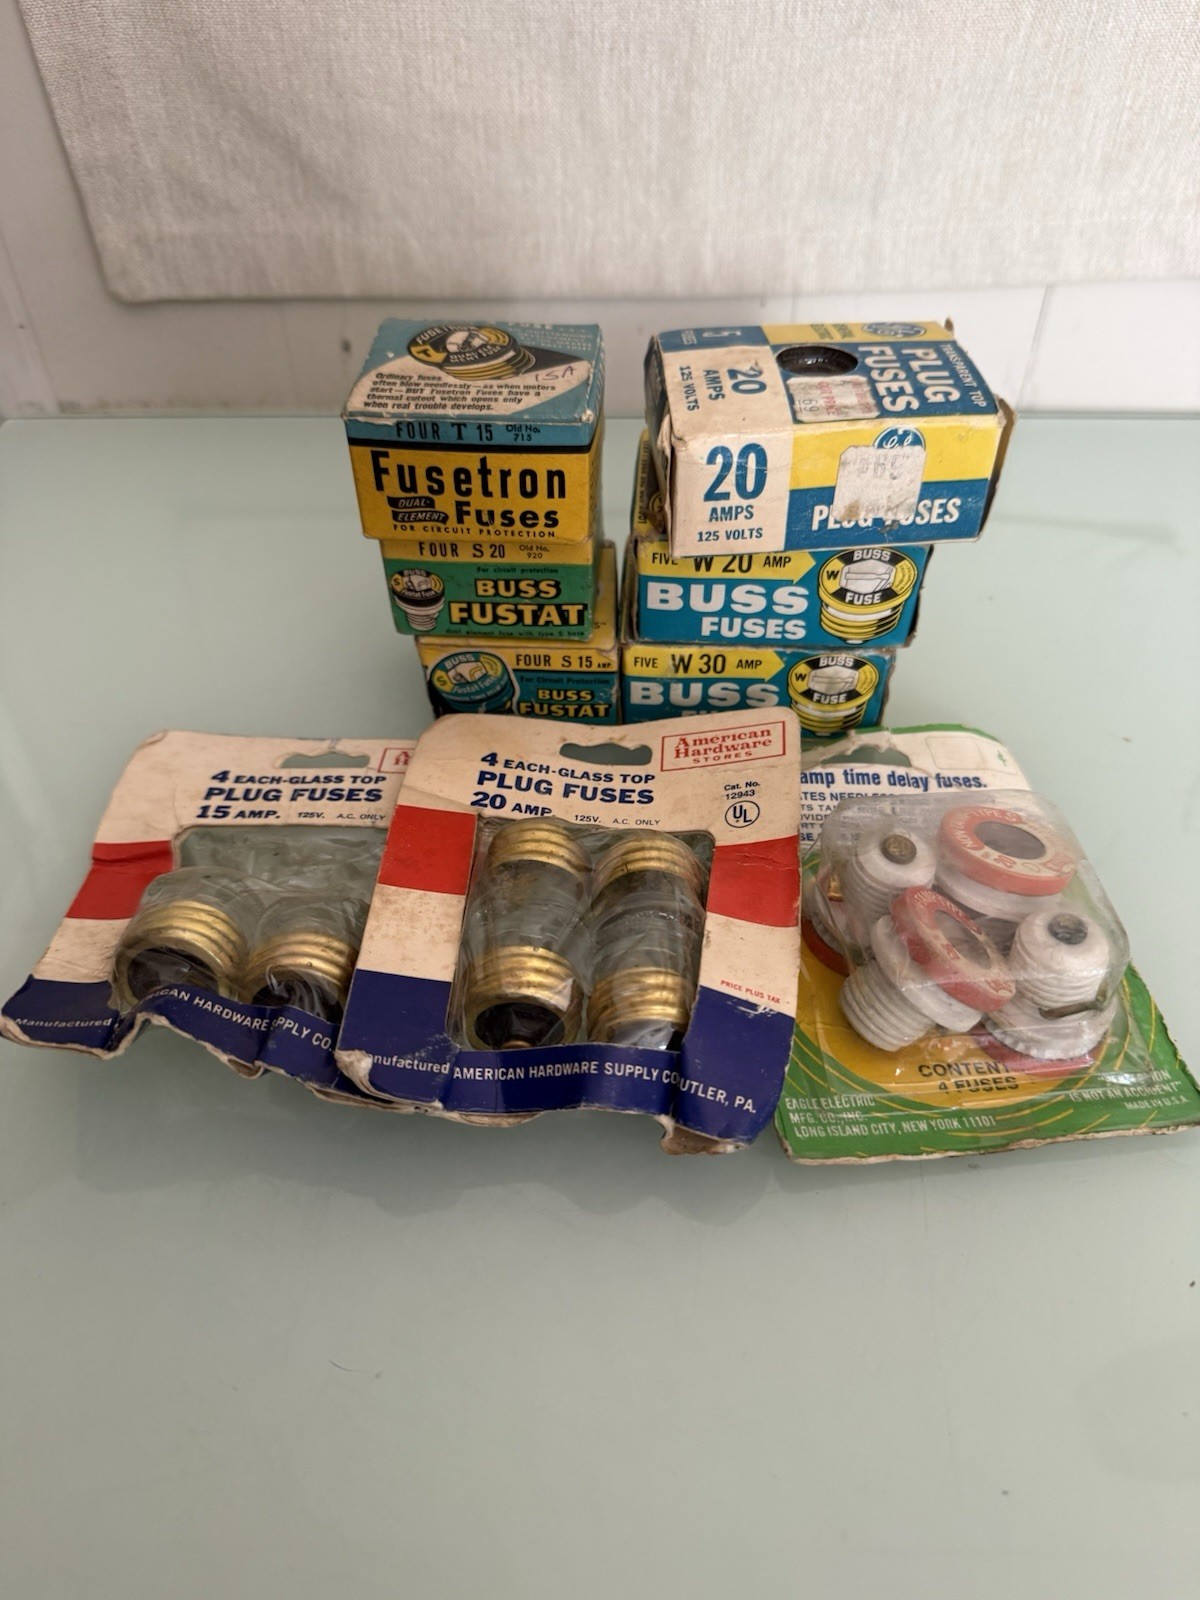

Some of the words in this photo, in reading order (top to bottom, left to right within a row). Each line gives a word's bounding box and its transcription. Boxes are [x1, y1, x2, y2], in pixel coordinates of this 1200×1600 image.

[376, 373, 414, 381] Ordinary
[679, 365, 693, 382] 125
[727, 363, 767, 395] 20
[858, 345, 920, 412] FUSES
[901, 348, 960, 403] PLUG
[939, 343, 978, 388] TRANSPARENT
[968, 390, 987, 408] TOP
[703, 369, 726, 401] AMPS
[503, 397, 523, 405] only
[683, 383, 700, 412] VOLTS
[391, 402, 411, 410] real
[450, 403, 494, 412] develops.
[395, 421, 440, 440] FOUR
[450, 422, 467, 441] T
[476, 423, 494, 442] 15
[506, 424, 521, 433] Old
[513, 433, 533, 442] 715
[370, 450, 567, 500] Fusetron
[703, 443, 768, 502] 20
[397, 511, 447, 522] ELEMENT
[454, 500, 560, 529] Fuses
[708, 505, 755, 523] AMPS
[393, 524, 416, 532] FOR
[423, 526, 471, 535] CIRCUIT
[479, 529, 556, 538] PROTECTION
[696, 531, 720, 543] 125
[725, 527, 764, 541] VOLTS
[418, 541, 460, 558] FOUR
[472, 543, 484, 558] S
[490, 543, 506, 559] 20
[518, 543, 534, 552] Old
[536, 544, 550, 553] No.
[526, 551, 543, 560] 920
[852, 549, 892, 561] BUSS
[520, 567, 559, 575] protection
[693, 555, 715, 572] W
[721, 554, 754, 573] 20
[763, 556, 792, 568] AMP
[826, 570, 840, 581] W
[474, 579, 559, 599] BUSS
[646, 581, 810, 615] BUSS
[844, 592, 883, 606] FUSE
[449, 602, 586, 627] FUSTAT
[701, 616, 808, 640] FUSES
[443, 653, 475, 670] BUSS
[515, 654, 552, 667] FOUR
[561, 655, 573, 668] S
[578, 656, 593, 669] 15
[633, 656, 659, 669] FIVE
[671, 653, 693, 674] W
[698, 653, 727, 675] 30
[736, 659, 763, 670] AMP
[818, 656, 856, 668] BUSS
[794, 672, 807, 682] W
[537, 688, 594, 702] BUSS
[630, 681, 780, 708] BUSS
[812, 693, 848, 705] FUSE
[519, 701, 610, 718] FUSTAT
[675, 728, 772, 749] American
[674, 738, 773, 759] Hardware
[692, 750, 753, 764] STORES
[480, 752, 499, 767] 4
[503, 759, 614, 783] EACH-GLASS
[620, 773, 656, 785] TOP
[211, 770, 232, 784] 4
[233, 775, 344, 785] EACH-GLASS
[350, 775, 388, 785] TOP
[800, 771, 836, 789] amp
[843, 769, 881, 786] time
[887, 771, 929, 792] delay
[935, 773, 988, 789] fuses.
[203, 788, 283, 802] PLUG
[290, 789, 384, 802] FUSES
[477, 770, 553, 797] PLUG
[562, 783, 655, 805] FUSES
[724, 783, 742, 792] Cat.
[745, 781, 760, 789] No.
[725, 789, 755, 801] 12943
[196, 805, 232, 819] 15
[233, 809, 282, 820] AMP.
[298, 812, 326, 820] 125V.
[337, 812, 357, 821] A.C.
[360, 813, 387, 822] ONLY
[471, 791, 507, 810] 20
[574, 814, 602, 824] 125V.
[612, 818, 631, 826] A.C.
[635, 818, 662, 827] ONLY
[732, 805, 753, 823] UL
[720, 979, 743, 992] PRICE
[745, 987, 765, 999] PLUS
[767, 994, 781, 1004] TAX
[14, 1018, 113, 1029] Manufactured
[193, 996, 270, 1032] HARDWARE
[272, 1016, 311, 1040] PPLY
[312, 1033, 333, 1051] CO.
[368, 1053, 450, 1074] nufactured
[453, 1066, 525, 1081] AMERICAN
[529, 1061, 599, 1078] HARDWARE
[604, 1061, 659, 1081] SUPPLY
[680, 1078, 729, 1107] UTLER,
[734, 1095, 757, 1114] PA.
[938, 1081, 950, 1094] 4
[954, 1075, 1020, 1093] FUSES
[785, 1097, 819, 1110] EAGLE
[820, 1095, 876, 1109] ELECTRIC
[1068, 1091, 1082, 1103] IS
[1082, 1089, 1106, 1101] NOT
[1106, 1088, 1124, 1099] AN
[1124, 1100, 1151, 1110] MADE
[1151, 1098, 1163, 1108] IN
[789, 1112, 818, 1124] MFG.
[794, 1125, 826, 1138] LONG
[827, 1124, 869, 1137] ISLAND
[870, 1121, 902, 1136] CITY,
[902, 1120, 928, 1133] NEW
[929, 1117, 961, 1131] YORK
[962, 1115, 996, 1129] 11101
